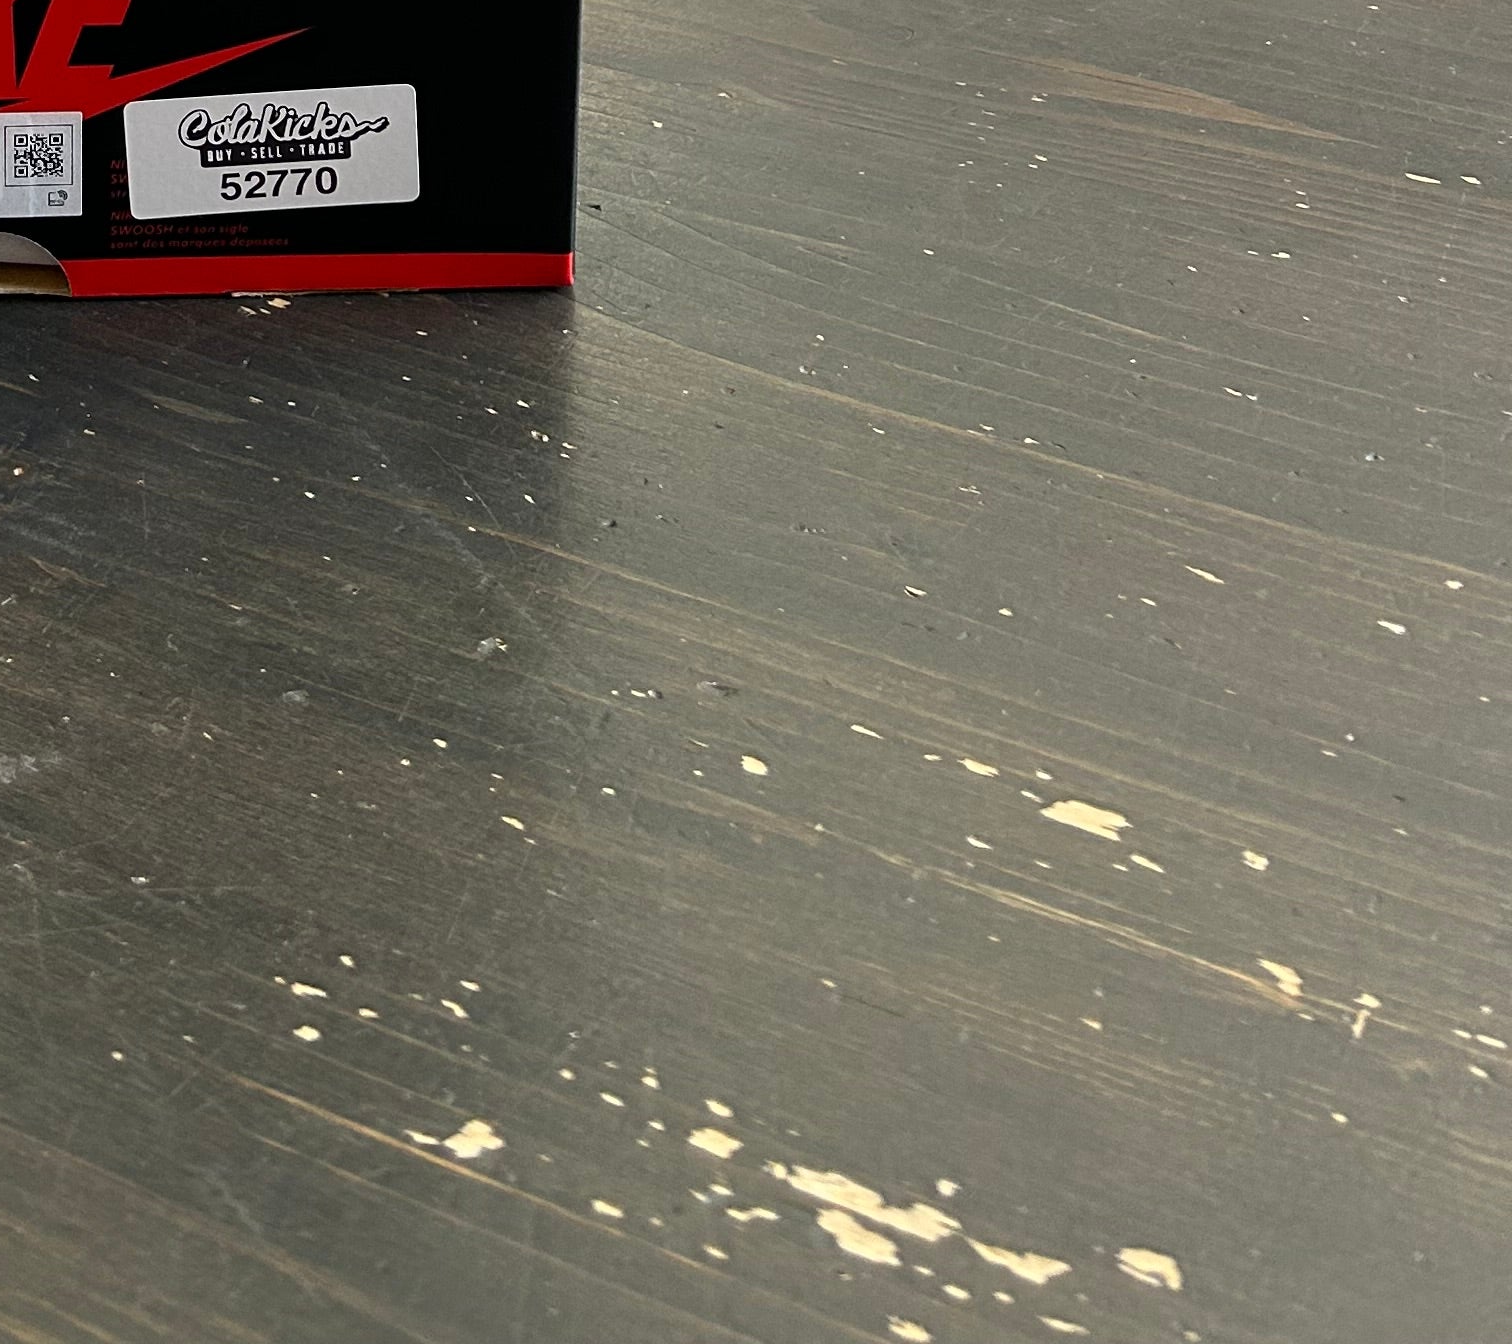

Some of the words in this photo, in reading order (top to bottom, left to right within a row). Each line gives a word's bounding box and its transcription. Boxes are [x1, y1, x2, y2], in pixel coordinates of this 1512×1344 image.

[207, 148, 232, 162] BUY
[251, 146, 282, 159] SELL
[300, 141, 345, 156] TRADE
[220, 166, 338, 201] 52770
